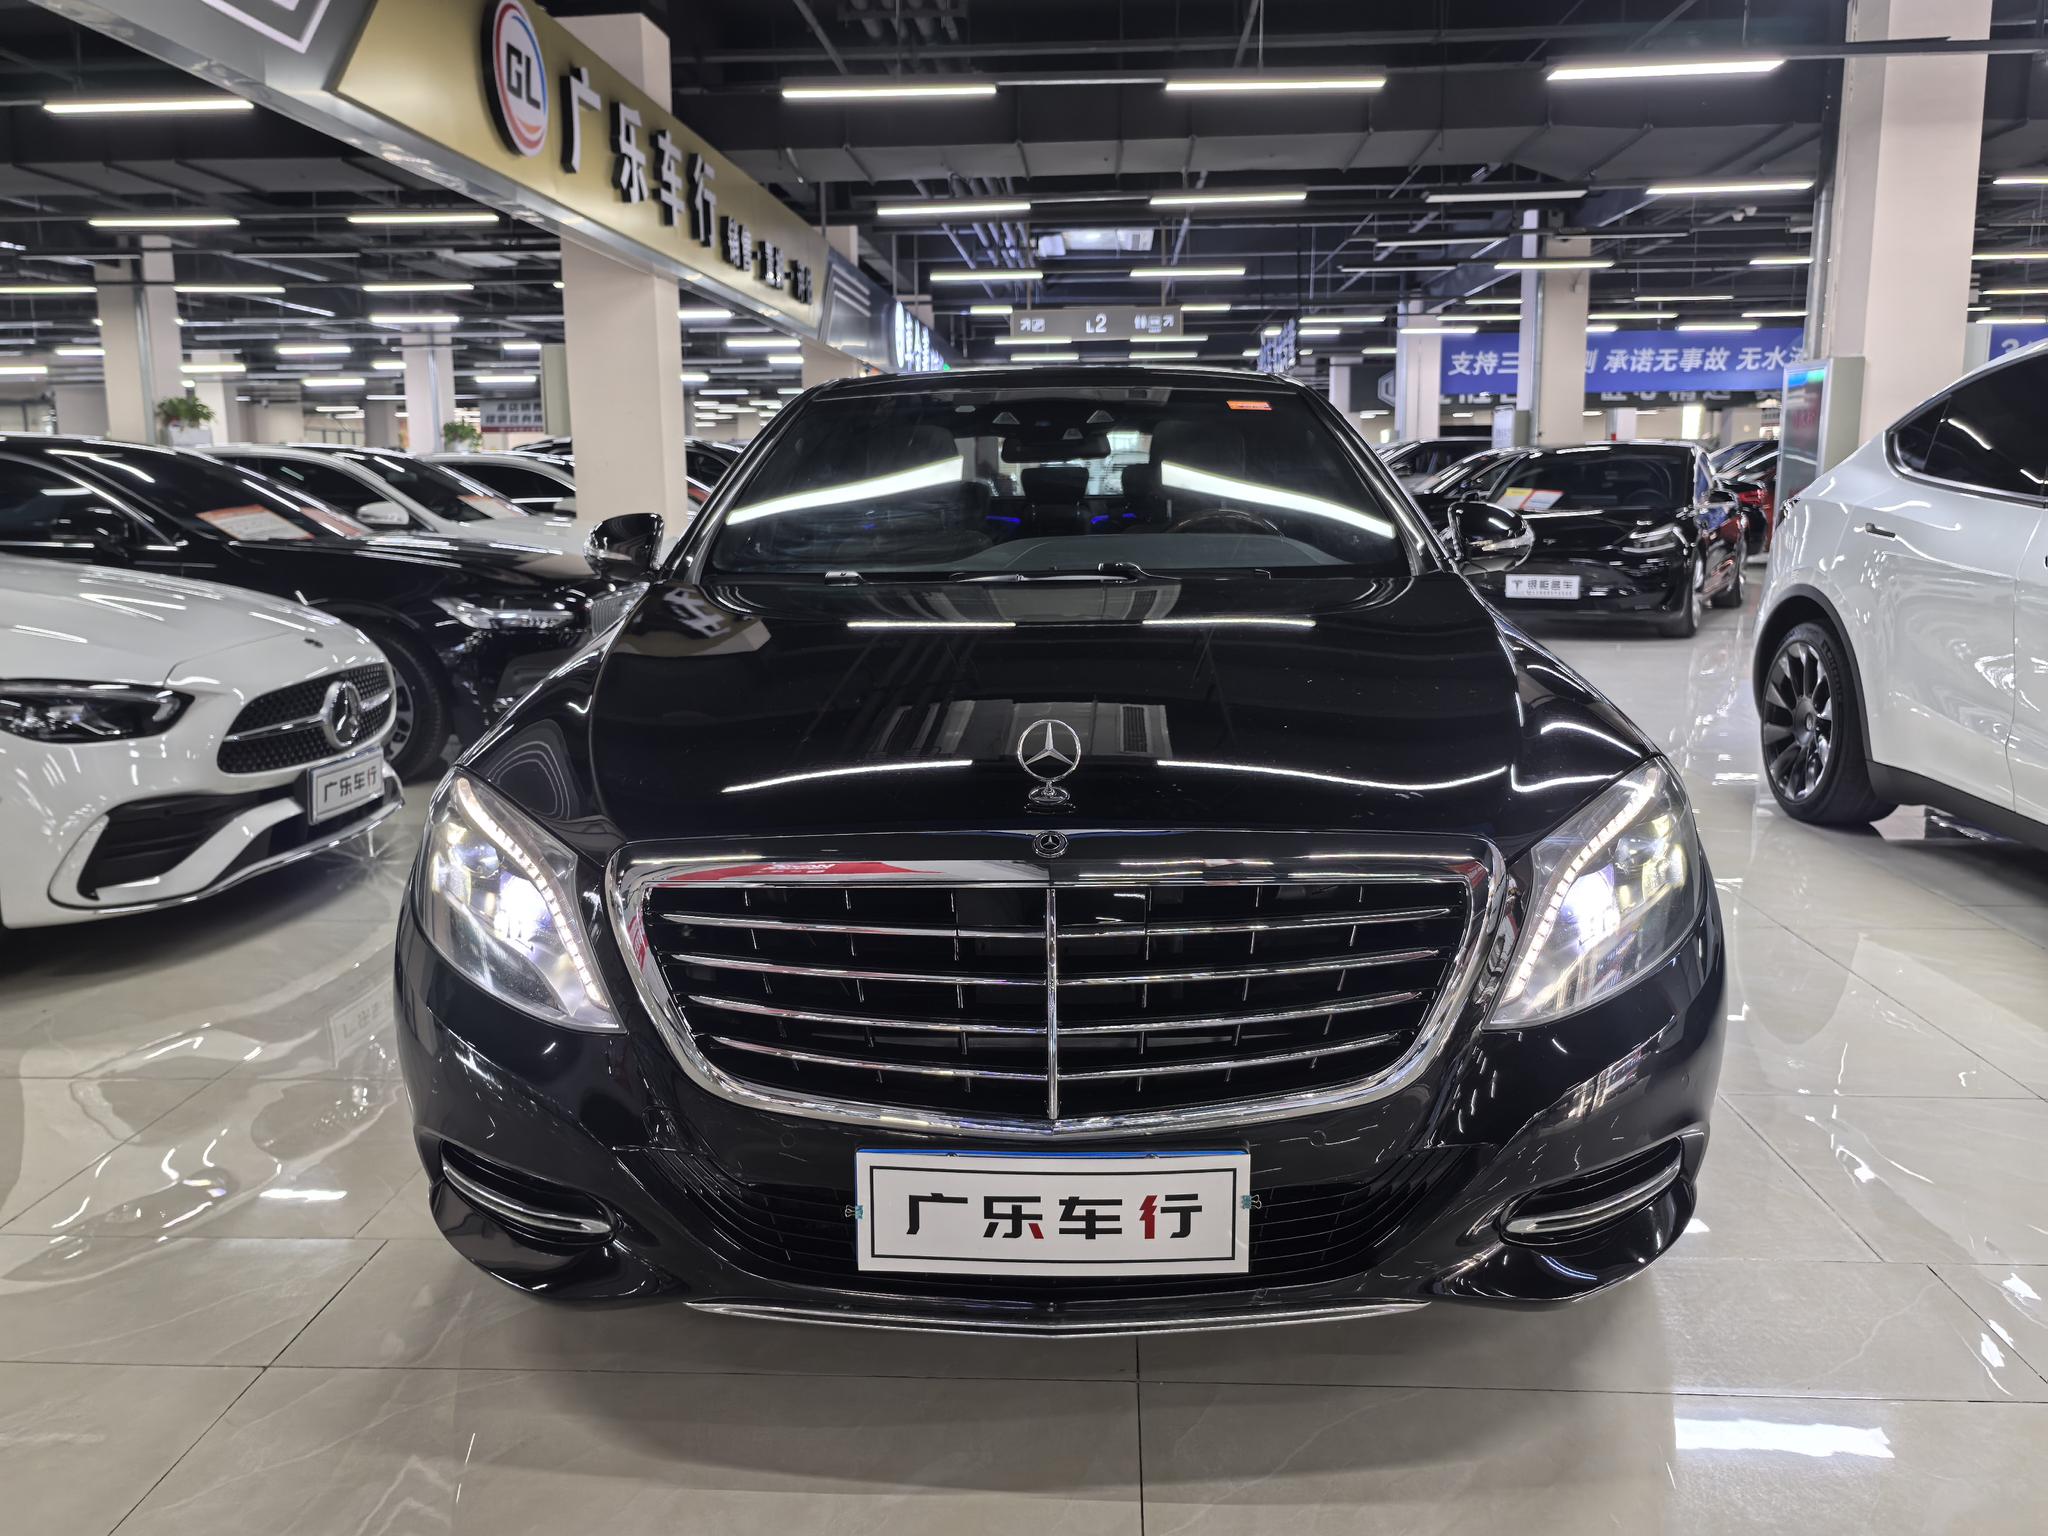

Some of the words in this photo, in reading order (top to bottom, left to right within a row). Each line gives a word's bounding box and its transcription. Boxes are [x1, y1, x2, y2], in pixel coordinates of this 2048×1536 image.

[506, 42, 541, 111] GL
[564, 66, 717, 247] 广乐车行
[1085, 313, 1107, 333] L2
[1603, 347, 1731, 373] 承诺无事故
[324, 765, 377, 803] 广乐车行
[906, 1192, 1203, 1240] 广乐车行
